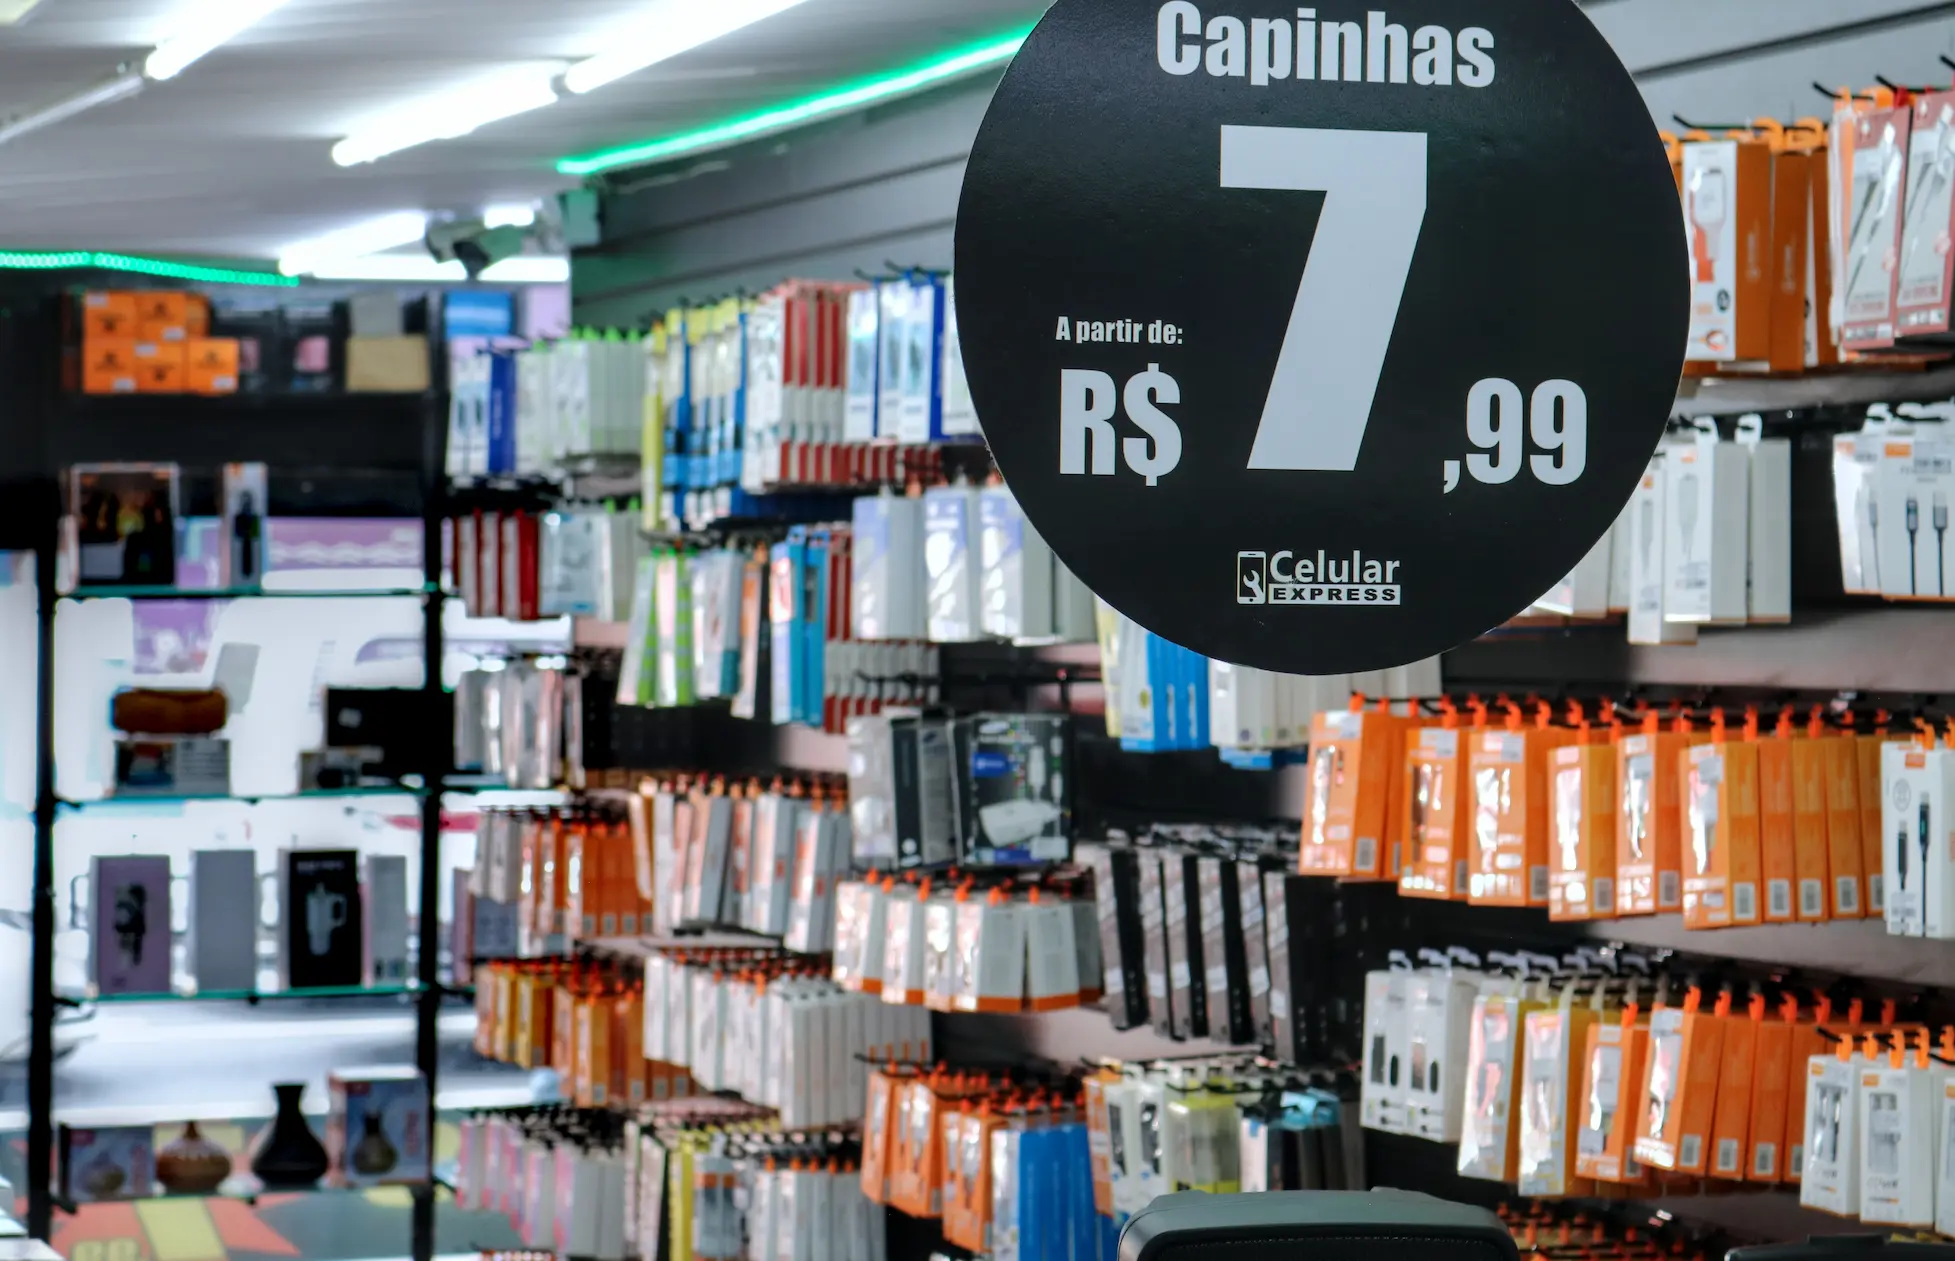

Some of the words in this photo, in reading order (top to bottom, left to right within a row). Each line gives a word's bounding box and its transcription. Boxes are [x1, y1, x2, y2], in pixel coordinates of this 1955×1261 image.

[1157, 0, 1496, 87] Capinhas
[1055, 316, 1071, 341] A
[1075, 319, 1143, 344] partir
[1147, 319, 1183, 345] de:
[1059, 363, 1183, 487] R$
[1269, 549, 1401, 584] Celular
[1272, 587, 1397, 602] EXPRESS
